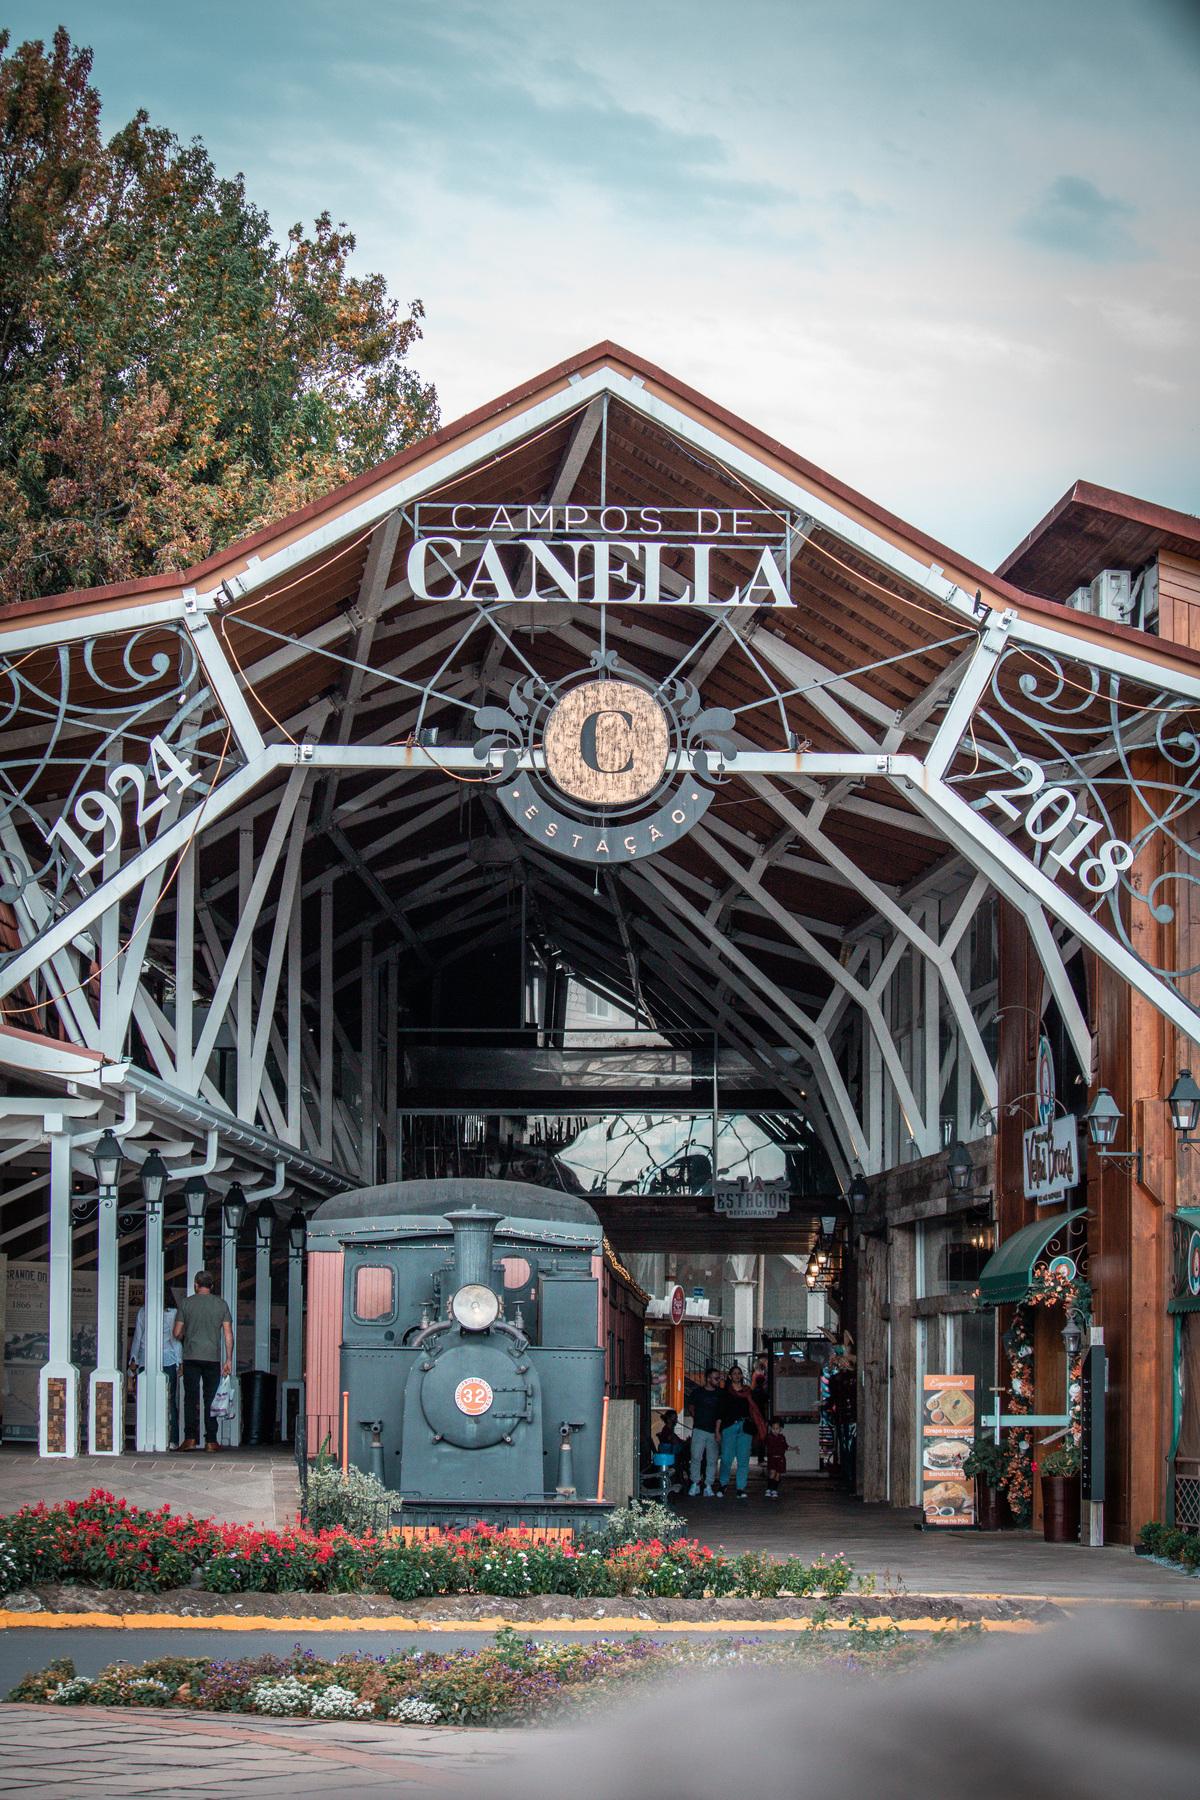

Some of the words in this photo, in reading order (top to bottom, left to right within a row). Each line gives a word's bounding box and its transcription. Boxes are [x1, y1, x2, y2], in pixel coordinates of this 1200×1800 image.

[452, 503, 663, 535] CAMPOS
[698, 509, 753, 536] DE
[407, 537, 798, 608] CANELLA
[579, 710, 636, 774] C
[45, 734, 202, 878] 1924
[524, 805, 687, 855] ESTAÇÃO
[984, 758, 1134, 893] 2018
[717, 1191, 787, 1209] ESTACIÓN
[737, 1176, 765, 1192] LA
[463, 1388, 485, 1404] 32
